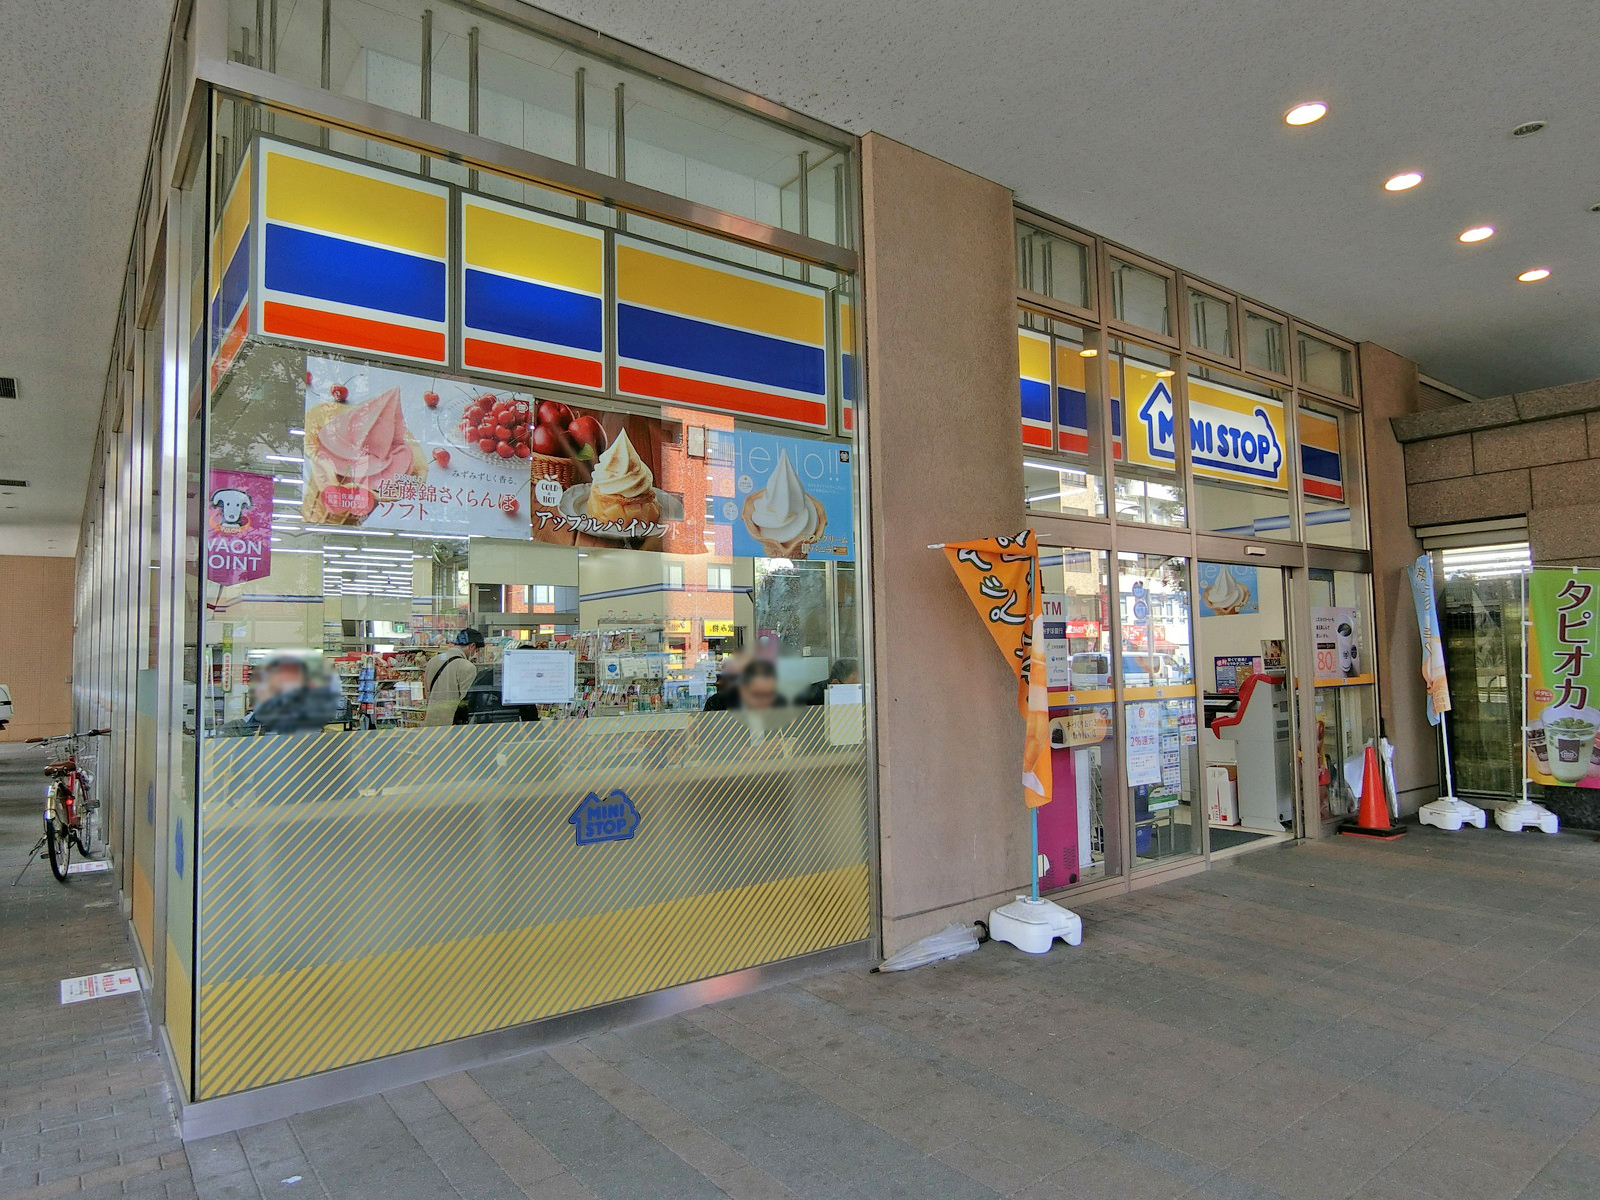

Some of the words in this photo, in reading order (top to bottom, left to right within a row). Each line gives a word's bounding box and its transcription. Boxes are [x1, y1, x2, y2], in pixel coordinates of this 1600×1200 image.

[1158, 409, 1214, 454] MNI
[1217, 424, 1270, 464] STOP
[378, 479, 516, 512] 佐藤錦さくらんぼ
[541, 483, 559, 492] COLD
[542, 496, 556, 504] HOT
[378, 502, 429, 521] ソフト
[535, 510, 681, 541] アップルパイソフト
[1042, 601, 1062, 616] TM
[1553, 579, 1592, 711] タピオカ
[1317, 650, 1333, 671] 80
[587, 803, 624, 820] MINI
[585, 818, 627, 837] STOP
